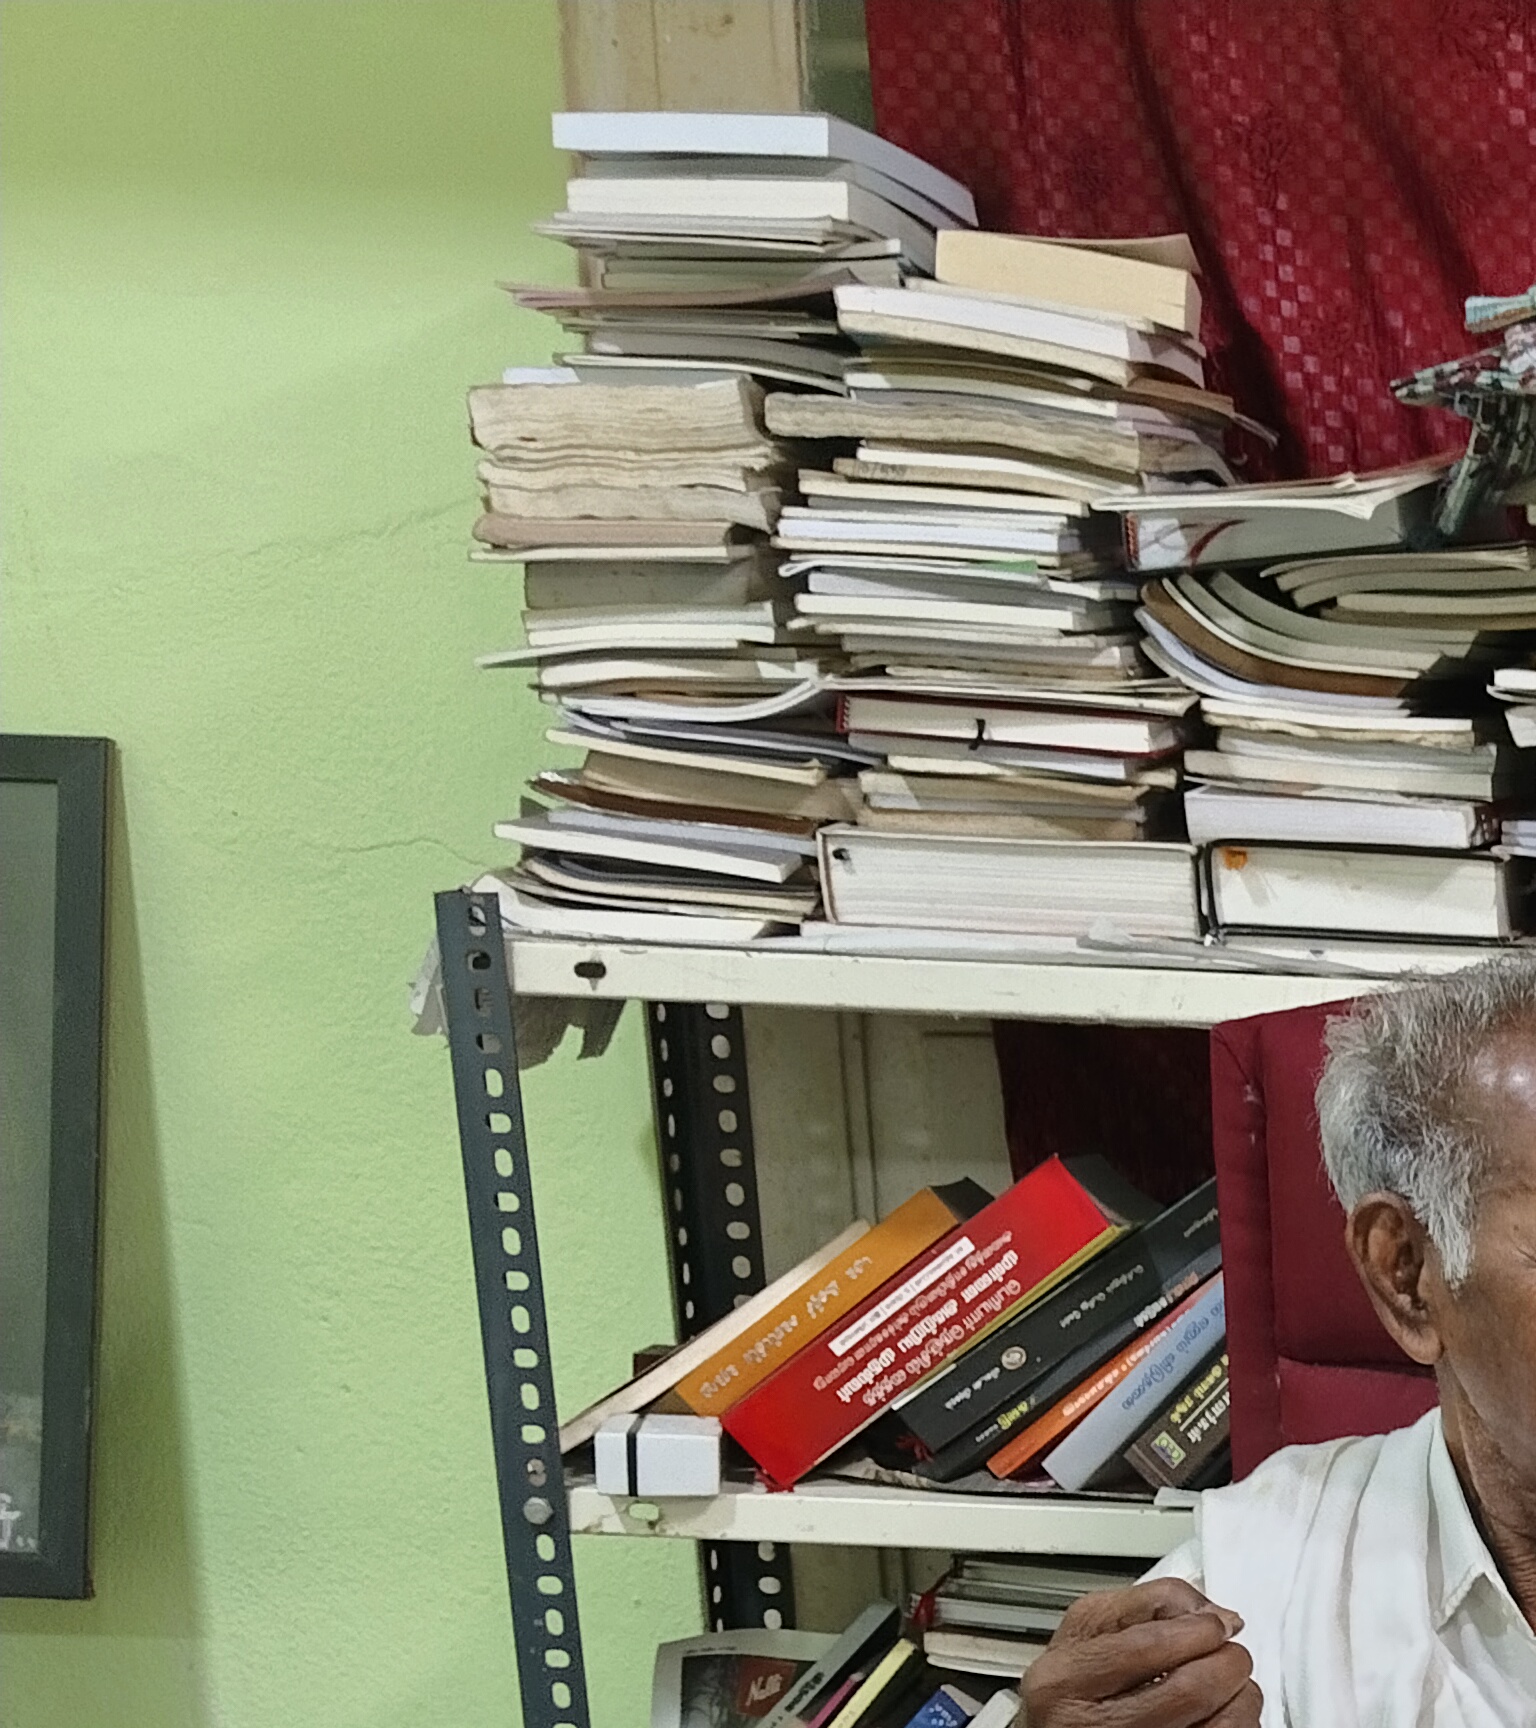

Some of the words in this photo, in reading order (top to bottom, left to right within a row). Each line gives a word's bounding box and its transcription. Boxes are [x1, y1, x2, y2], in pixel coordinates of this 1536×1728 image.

[892, 1294, 965, 1357] அகற்றிய
[959, 1276, 1026, 1333] பெரியார்
[831, 1344, 902, 1405] முதல்வர்
[899, 1318, 969, 1378] நெஞ்சில்
[1113, 1350, 1184, 1412] விடுதலை
